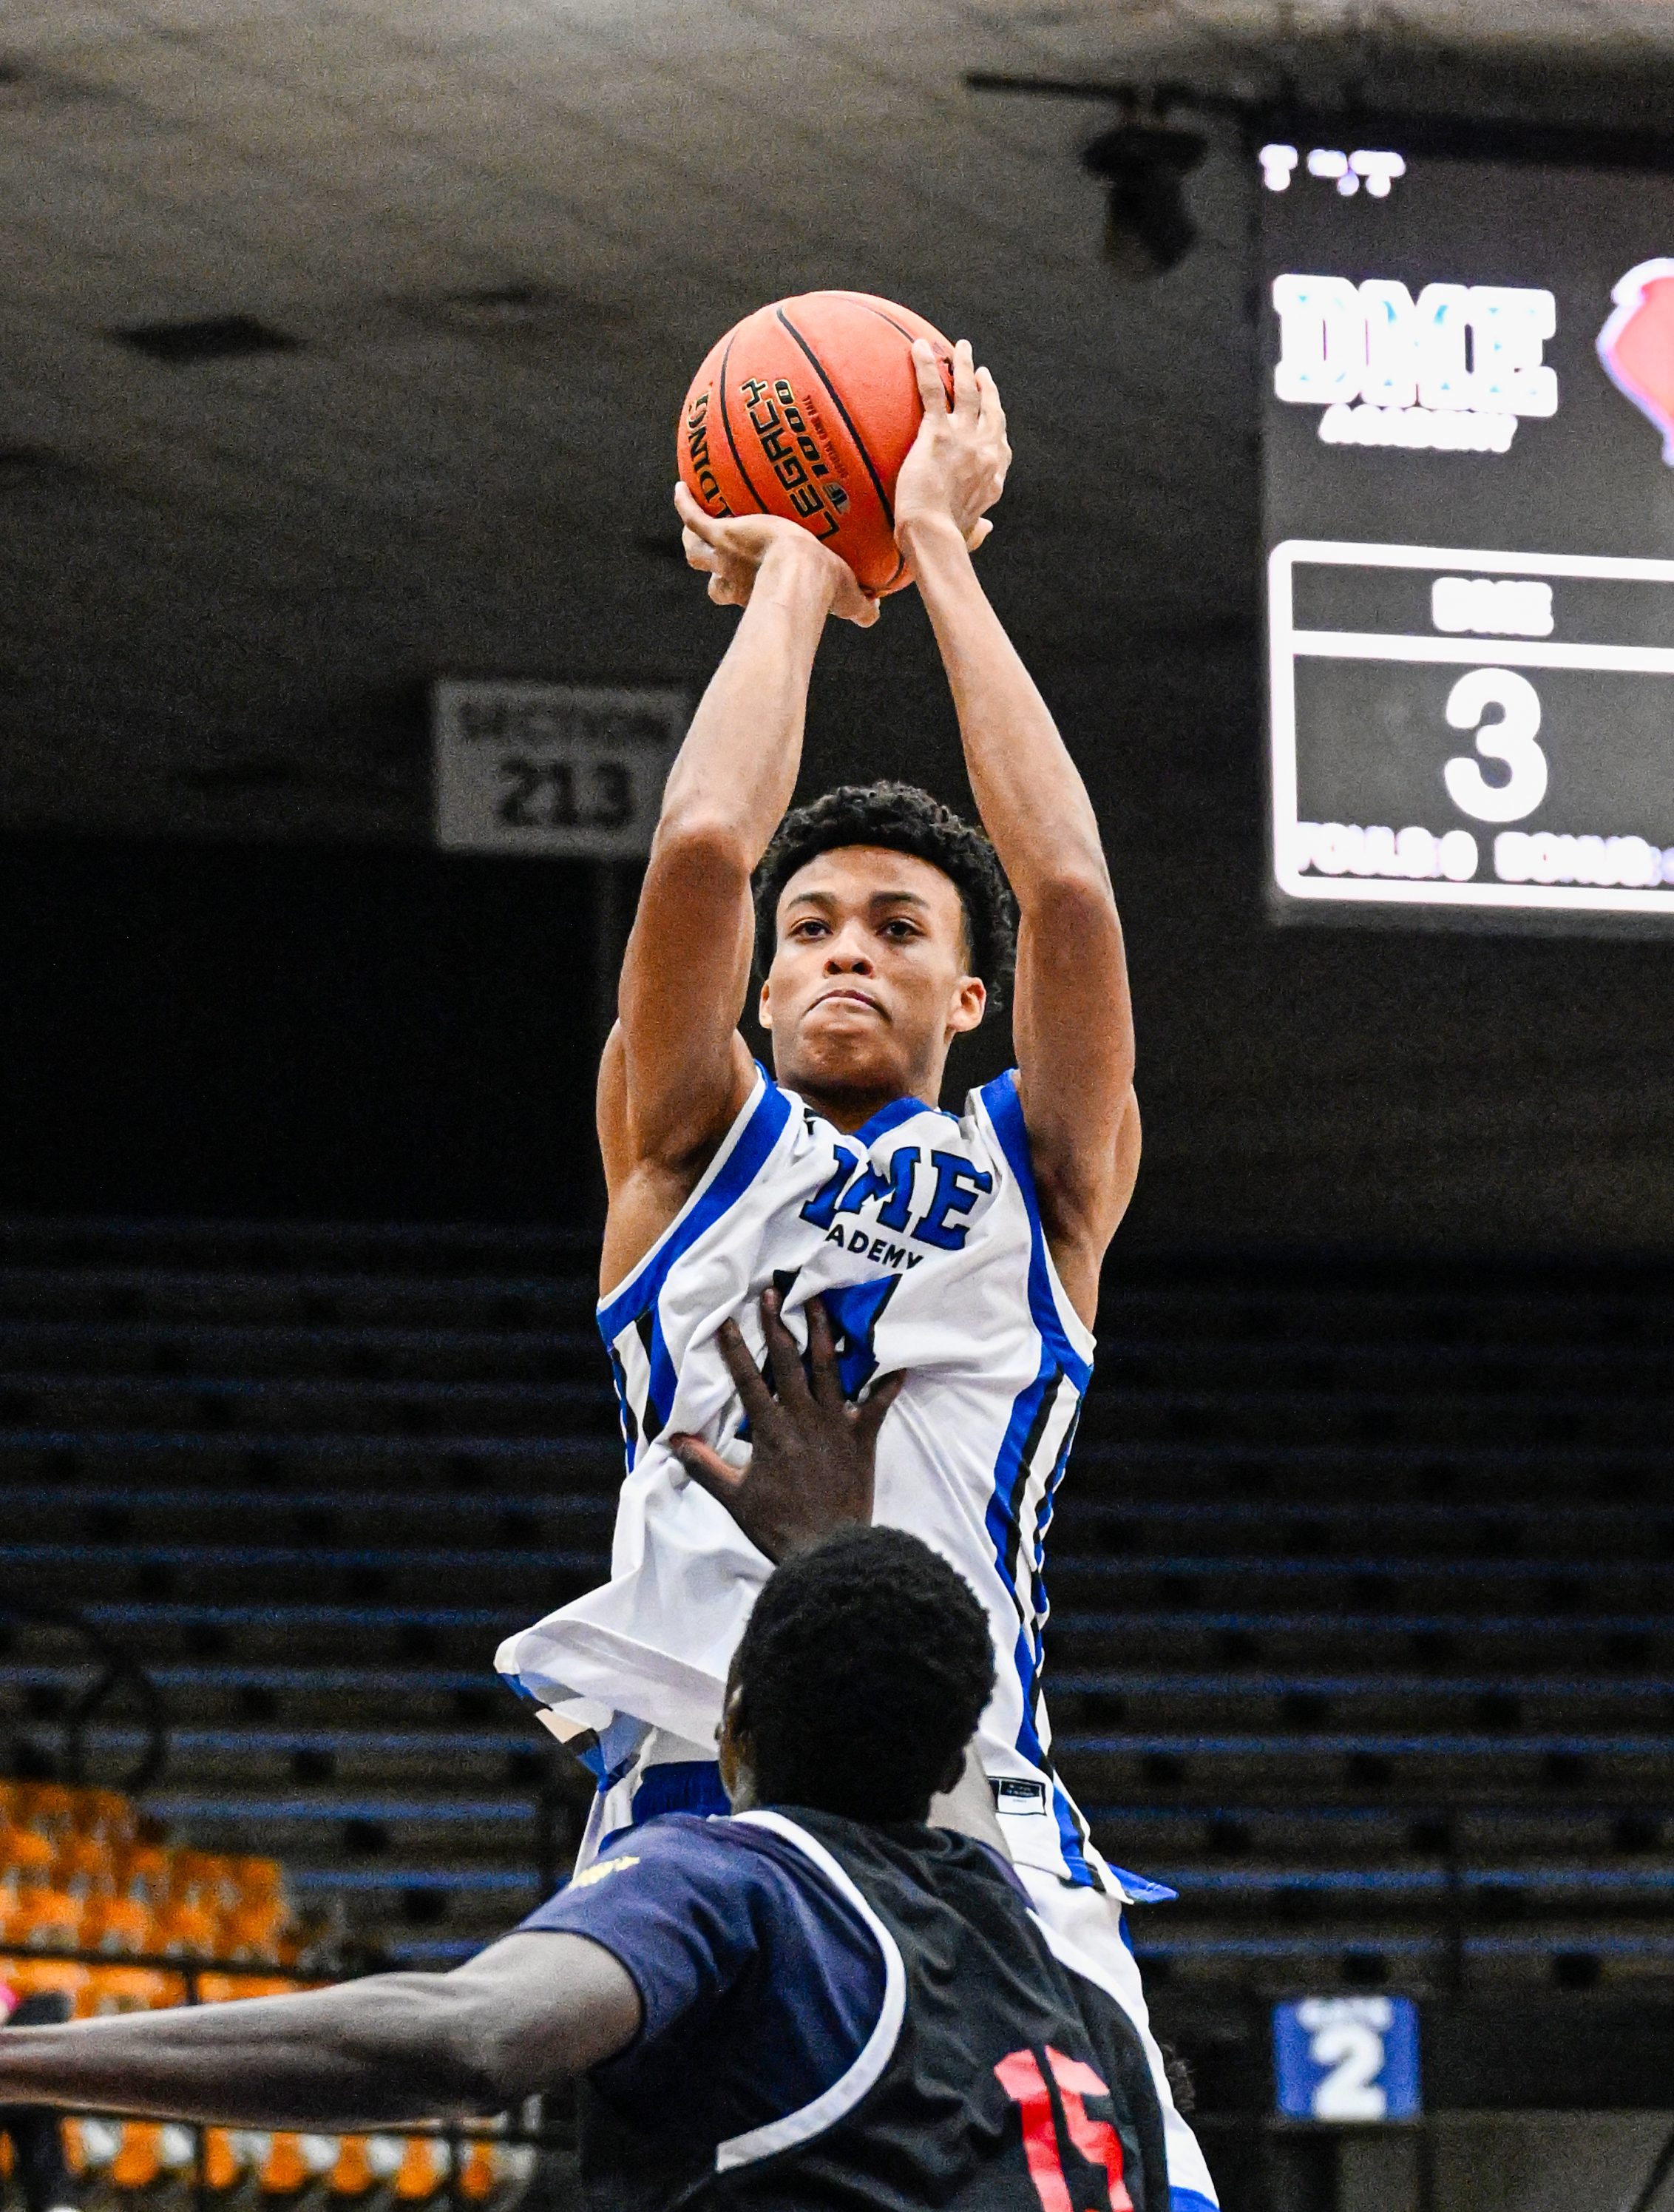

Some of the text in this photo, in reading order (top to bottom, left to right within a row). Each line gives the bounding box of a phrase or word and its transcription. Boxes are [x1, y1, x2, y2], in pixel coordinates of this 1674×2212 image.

[688, 391, 735, 519] LDING
[740, 378, 841, 541] LEGACY
[774, 379, 830, 479] 1000
[497, 757, 634, 829] 213
[1444, 667, 1548, 822] 3
[826, 1223, 924, 1271] ADEMY
[994, 2044, 1133, 2212] 15
[1309, 2023, 1387, 2123] 2
